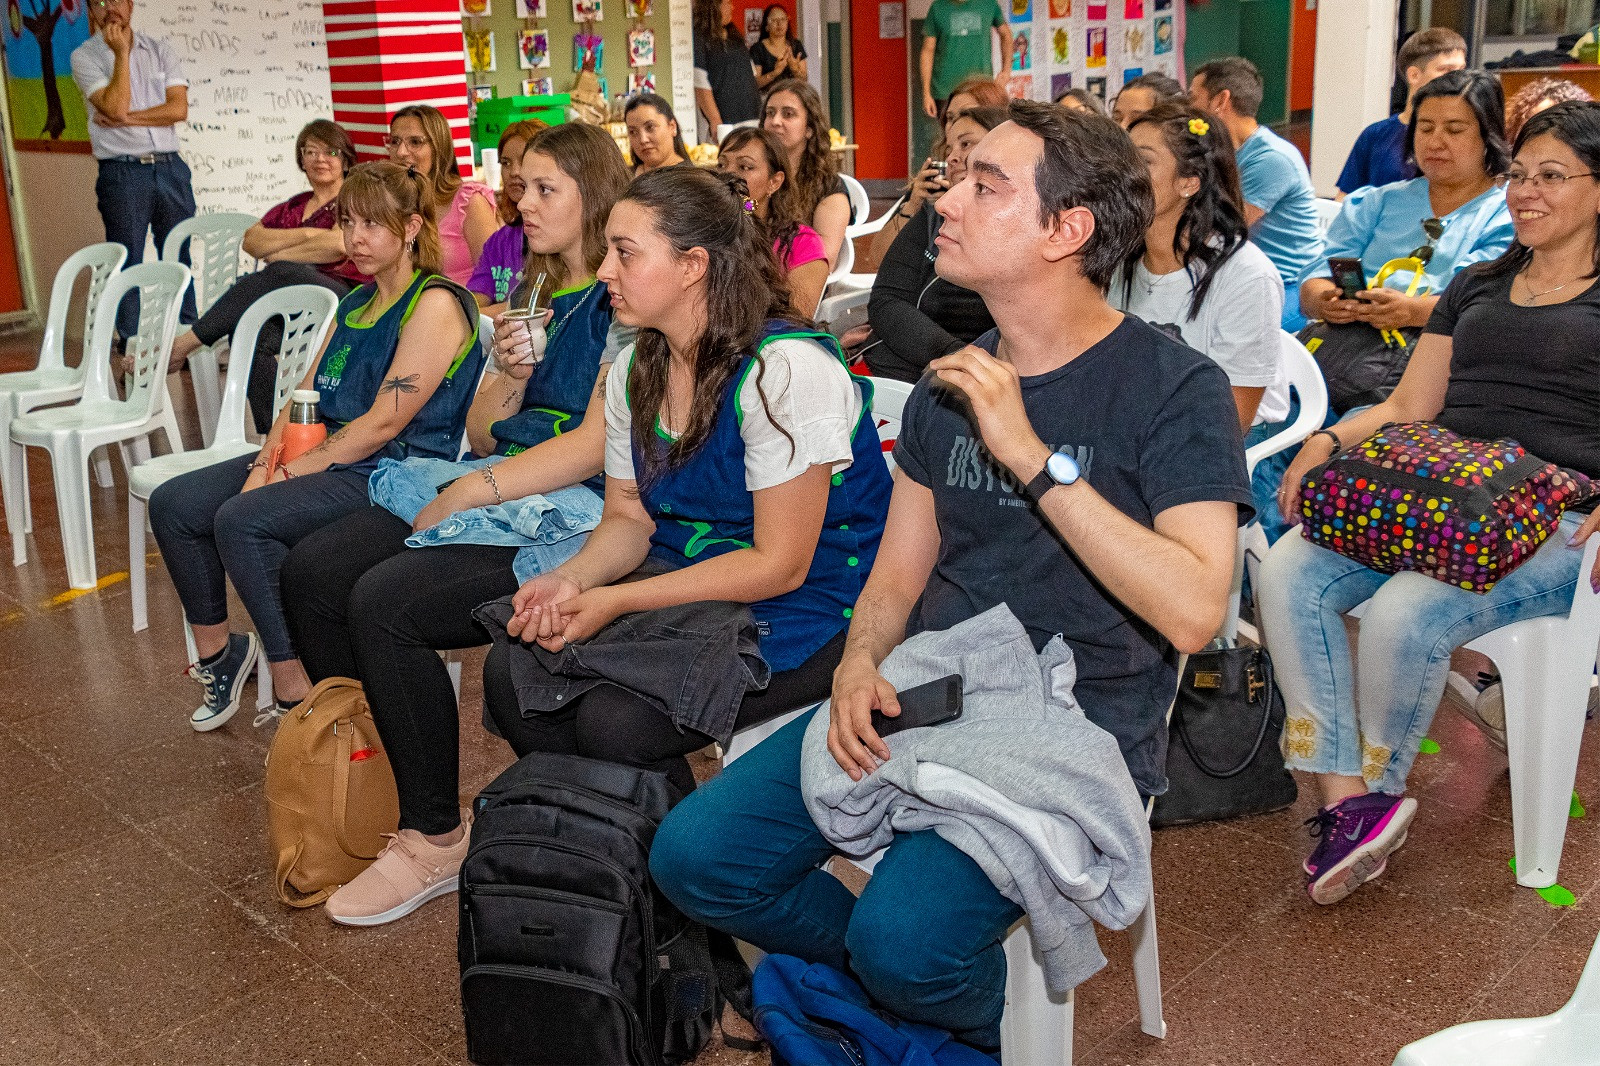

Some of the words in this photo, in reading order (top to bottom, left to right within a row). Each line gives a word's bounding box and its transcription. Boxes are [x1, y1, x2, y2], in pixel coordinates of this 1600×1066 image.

[174, 29, 241, 56] TOMAS
[263, 87, 324, 113] TOMAS
[998, 497, 1007, 507] BY
